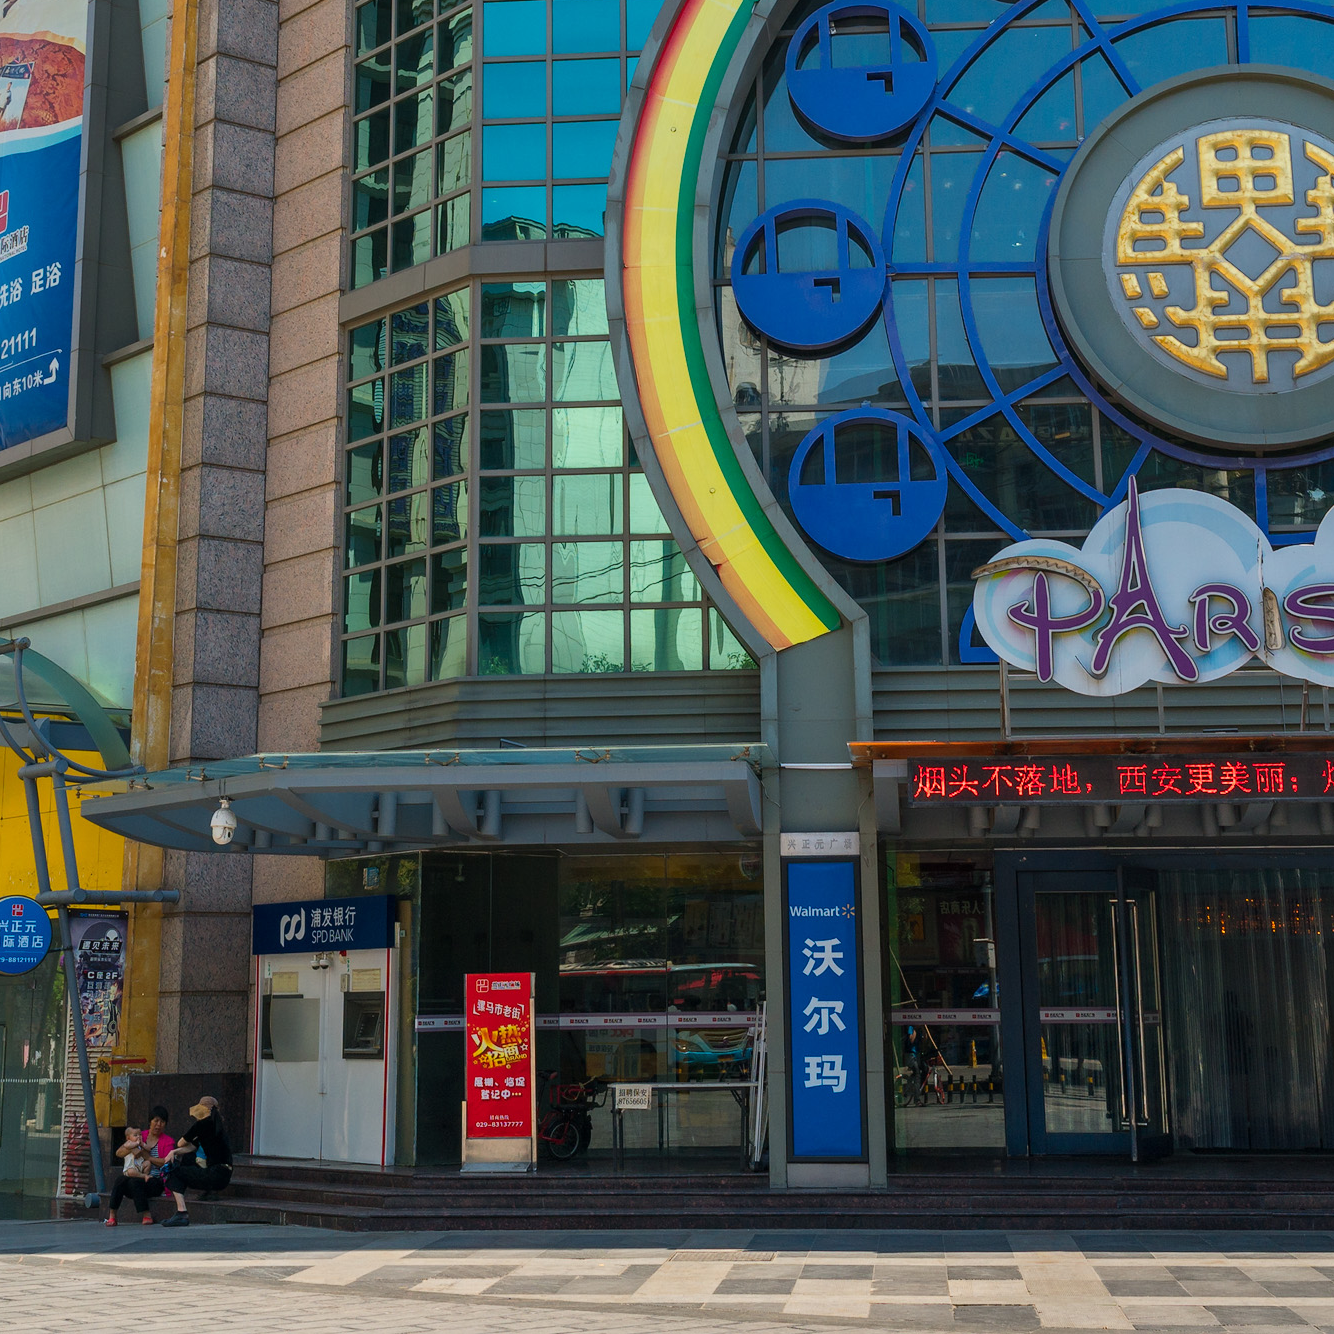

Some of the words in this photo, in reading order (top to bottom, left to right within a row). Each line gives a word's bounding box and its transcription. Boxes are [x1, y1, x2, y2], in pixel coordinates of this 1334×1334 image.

[30, 261, 62, 295] 足浴
[787, 839, 853, 851] 兴正元广场
[310, 905, 357, 928] 浦发银行
[789, 905, 841, 917] Walmart
[311, 929, 327, 944] SPD
[329, 927, 355, 943] BANK
[82, 940, 120, 951] 遇见未来
[477, 999, 521, 1020] 骡马市老街
[801, 937, 848, 1094] 沃尔玛
[618, 1088, 648, 1097] 招聘保安
